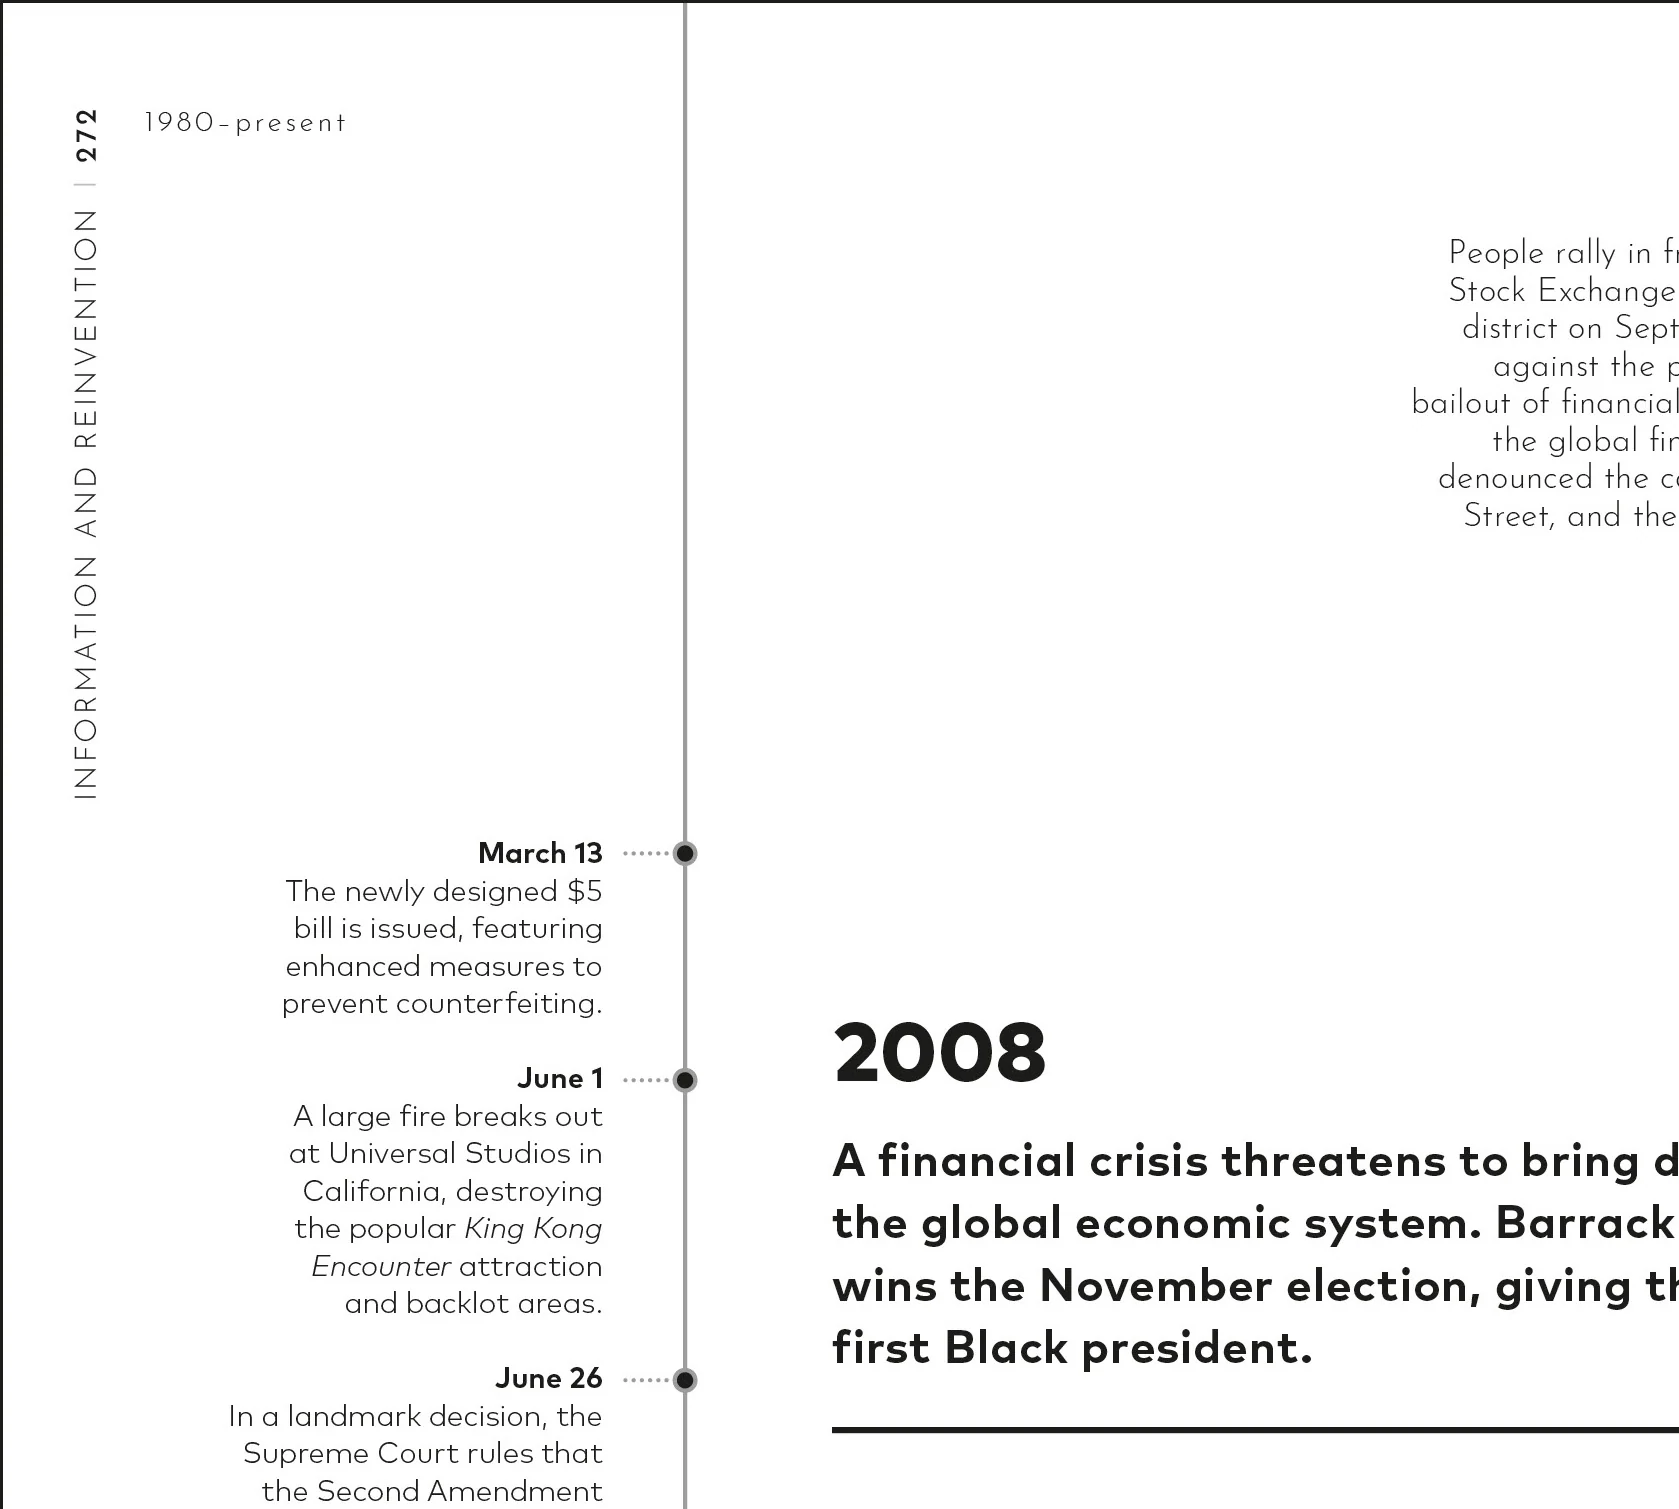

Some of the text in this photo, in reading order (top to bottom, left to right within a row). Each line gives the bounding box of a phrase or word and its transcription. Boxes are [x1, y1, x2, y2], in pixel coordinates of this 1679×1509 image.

[73, 109, 97, 799] INFORMATION AND REINVENTION 272
[479, 840, 603, 864] March 13
[285, 877, 602, 907] The newly designed $5
[834, 1021, 1046, 1083] 2008
[831, 1142, 866, 1177] A
[878, 1141, 1074, 1177] financial
[1090, 1141, 1208, 1177] crisis
[1221, 1141, 1446, 1177] threatens
[1459, 1146, 1508, 1177] to
[1523, 1141, 1638, 1186] bring
[832, 1203, 907, 1239] the
[922, 1203, 1060, 1248] global
[1076, 1203, 1290, 1239] economic
[1304, 1208, 1481, 1248] system.
[1497, 1203, 1676, 1239] Barrack
[832, 1328, 1312, 1373] first Black president.
